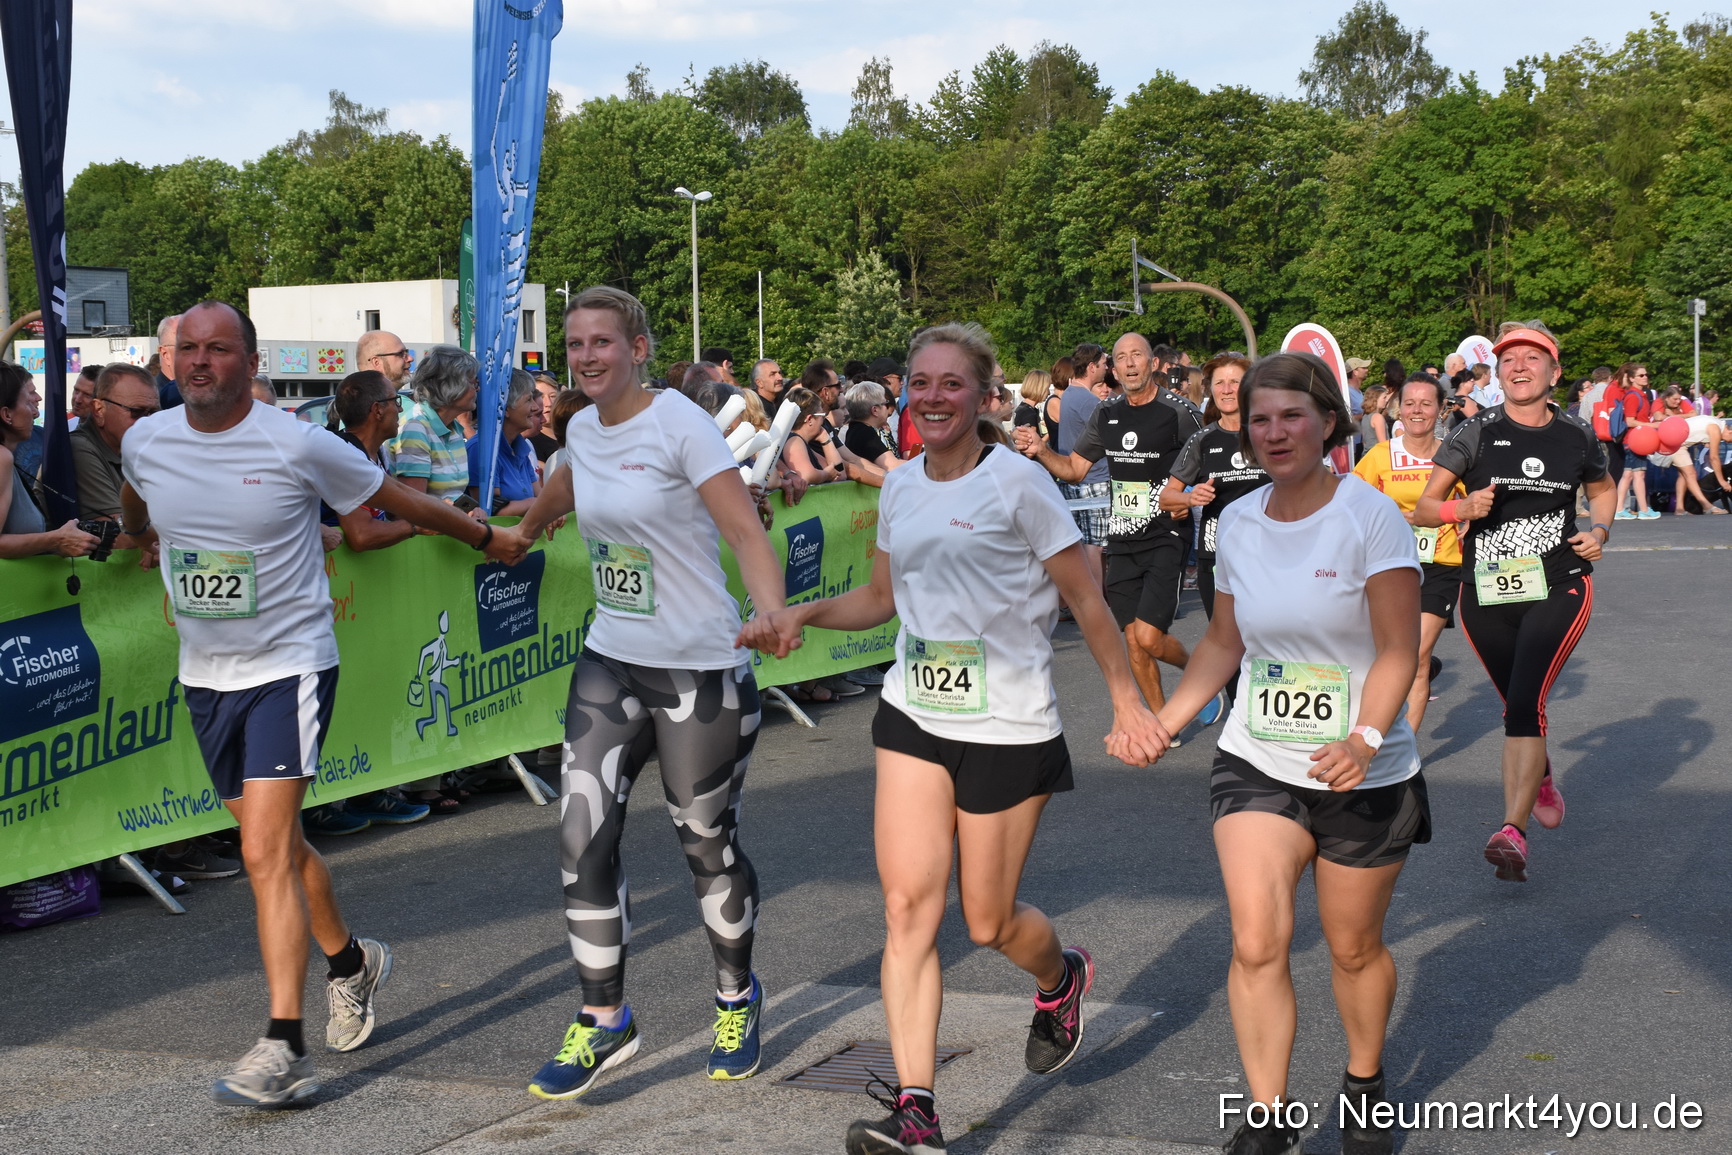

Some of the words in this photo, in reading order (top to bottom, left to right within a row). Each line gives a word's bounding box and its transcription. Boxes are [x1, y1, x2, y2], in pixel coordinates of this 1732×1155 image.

[1222, 474, 1259, 482] SCHOTTERWERKE
[1392, 473, 1420, 482] MAX
[1508, 484, 1554, 494] SCHOTTERWERKE
[1118, 494, 1138, 507] 104
[950, 518, 974, 531] Christa
[794, 543, 819, 561] Fischer
[596, 564, 642, 595] 1023
[1315, 569, 1336, 578] Silvia
[1496, 574, 1523, 591] 95
[179, 574, 242, 598] 1022
[487, 581, 531, 604] Fischer
[492, 596, 526, 612] AUTOMOBILE
[12, 644, 79, 677] Fischer
[460, 607, 593, 704] firmenlauf
[25, 663, 80, 688] AUTOMOBILE
[912, 663, 972, 692] 1024
[1320, 685, 1341, 693] 2019
[465, 687, 522, 727] neumarkt
[1259, 688, 1332, 721] 1026
[1268, 718, 1293, 727] Vohler
[1294, 720, 1318, 729] Silvia
[0, 675, 179, 799] menlauf
